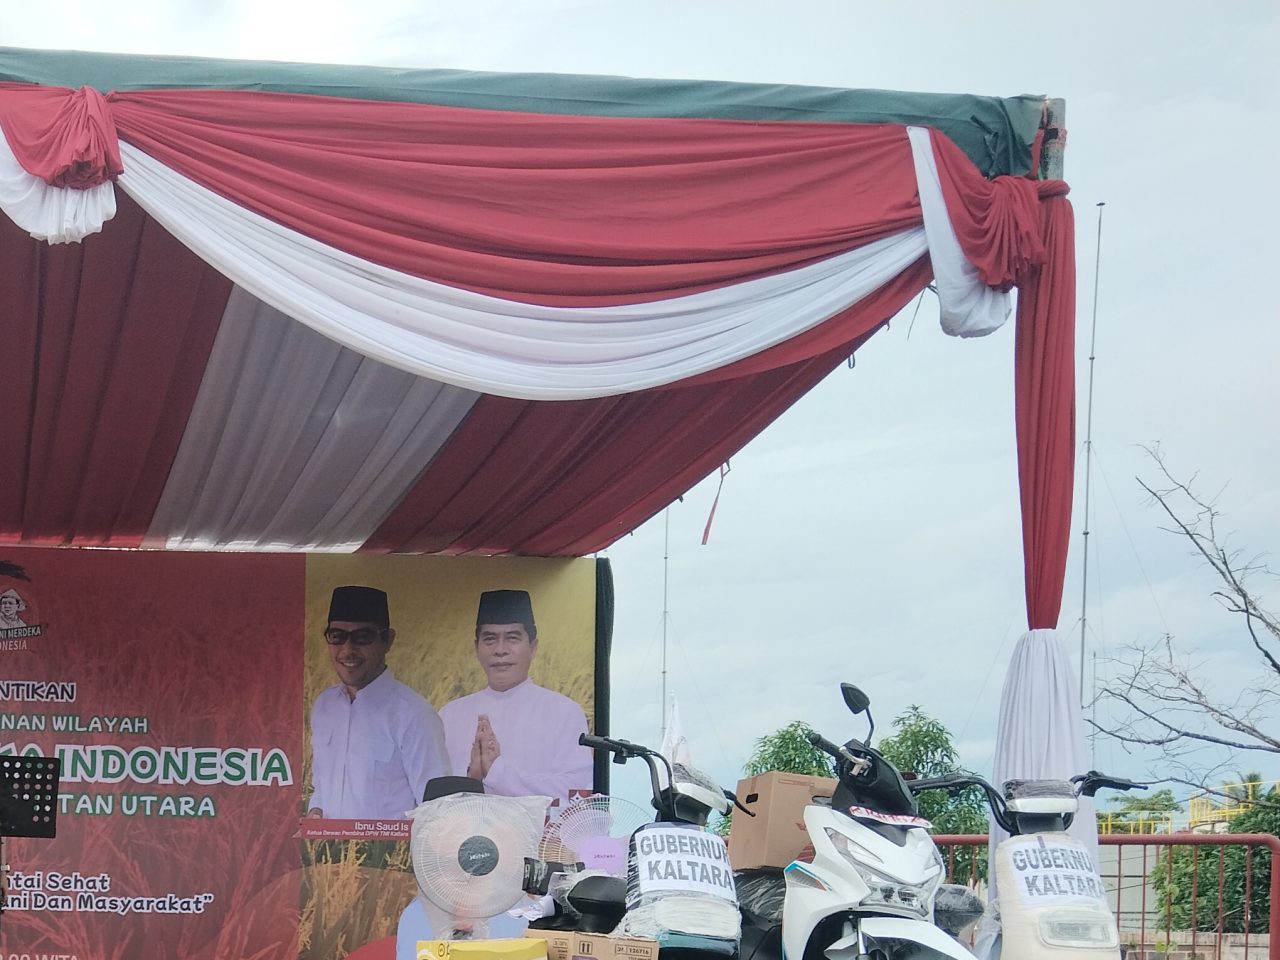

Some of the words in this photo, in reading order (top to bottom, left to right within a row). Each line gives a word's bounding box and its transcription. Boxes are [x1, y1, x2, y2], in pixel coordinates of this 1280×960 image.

[52, 715, 149, 734] WILAYAH
[56, 744, 293, 786] INDONESIA
[121, 795, 217, 817] UTARA
[354, 821, 375, 830] Ibnu
[376, 822, 400, 831] Saud
[1012, 848, 1095, 873] GUBERNU
[46, 873, 111, 891] Sehat
[647, 860, 734, 891] KALTARA
[32, 892, 74, 912] Dan
